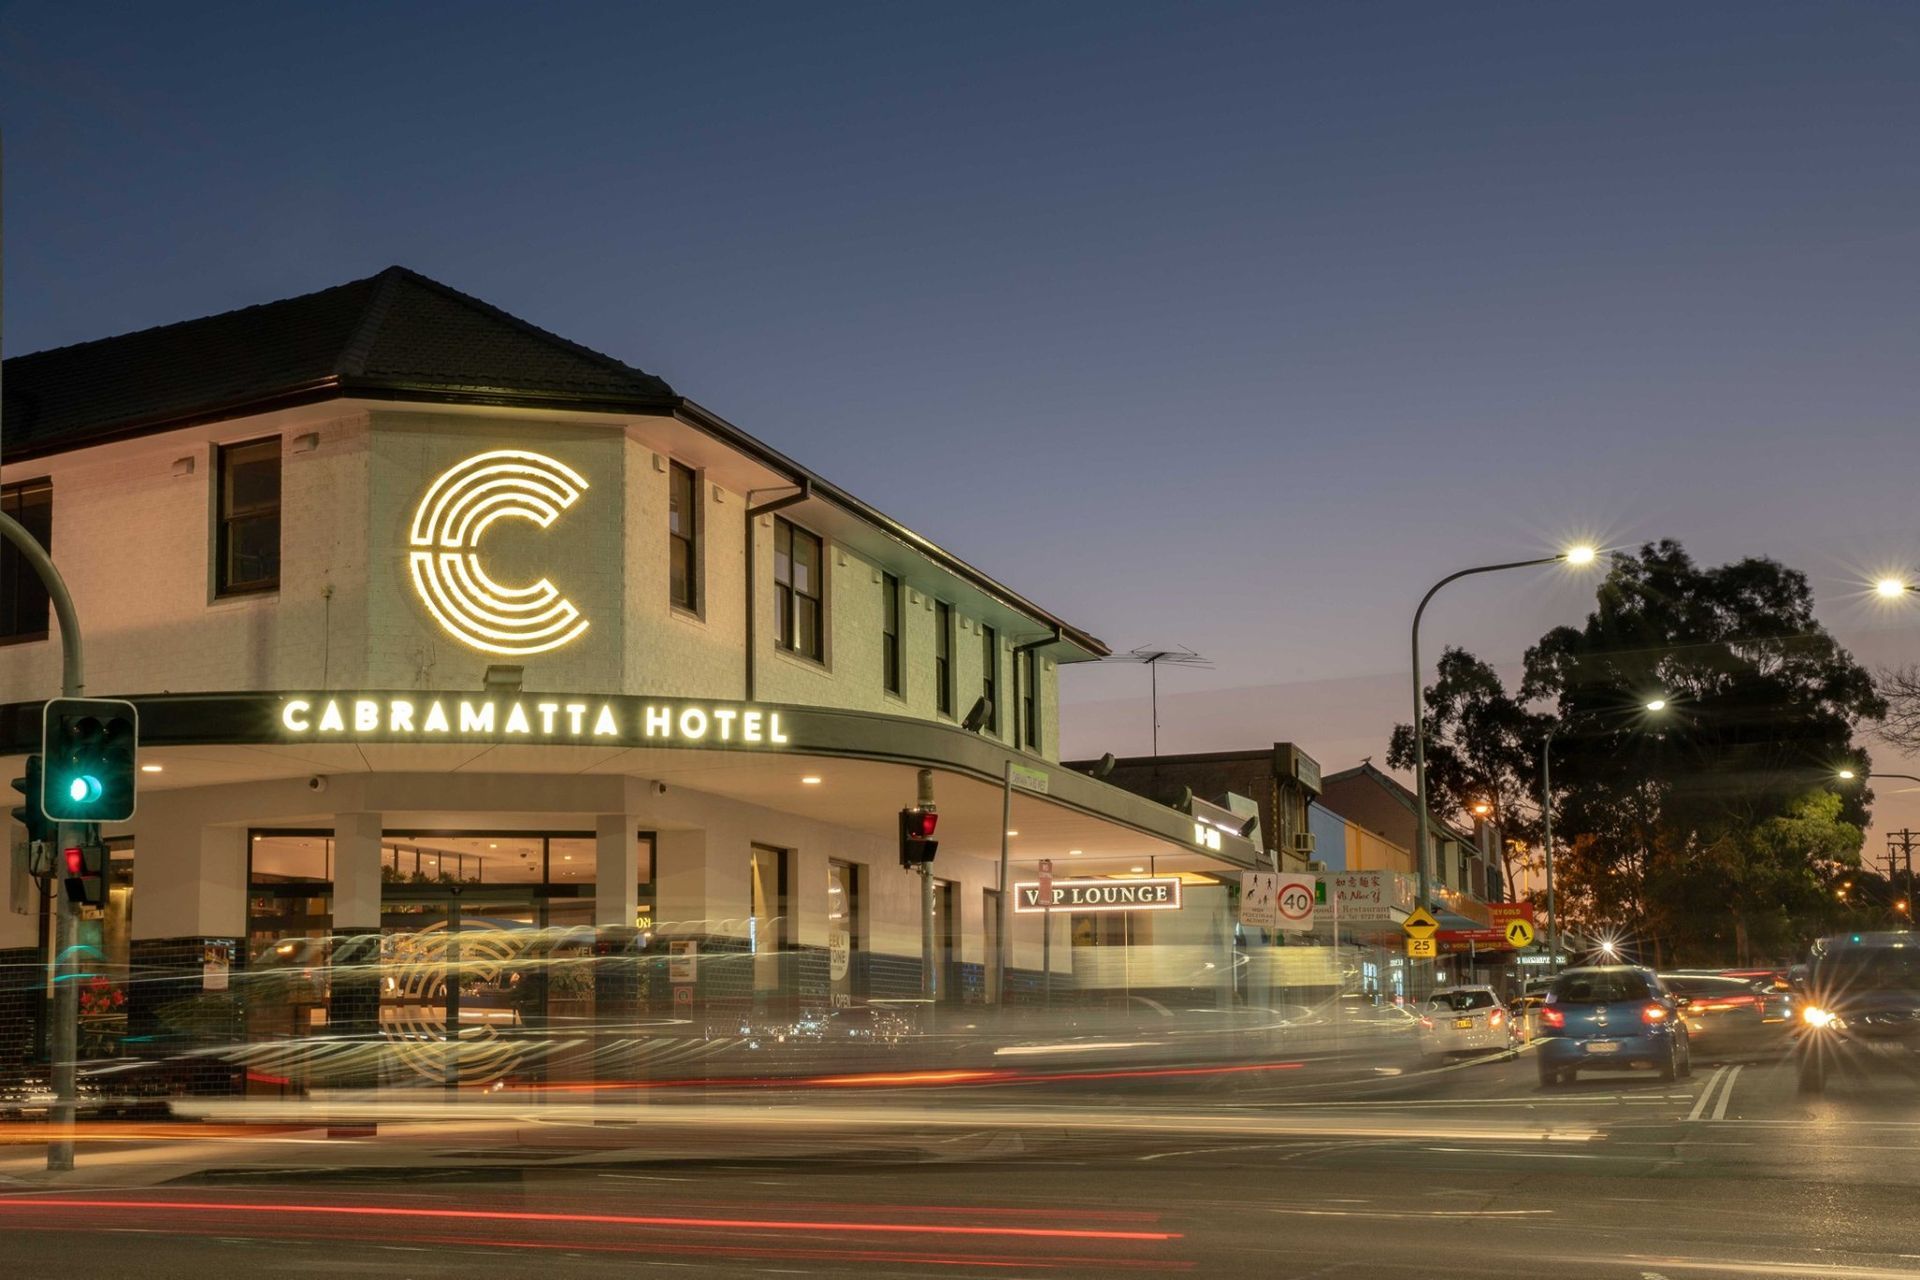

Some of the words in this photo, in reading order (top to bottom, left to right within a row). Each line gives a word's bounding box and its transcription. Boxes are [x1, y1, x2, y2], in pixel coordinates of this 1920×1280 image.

[282, 700, 618, 735] CABRAMATTA
[646, 706, 788, 743] HOTEL
[1026, 889, 1065, 906] VP
[1072, 885, 1168, 904] LOUNGE
[1284, 893, 1308, 911] 40
[1414, 940, 1431, 951] 25
